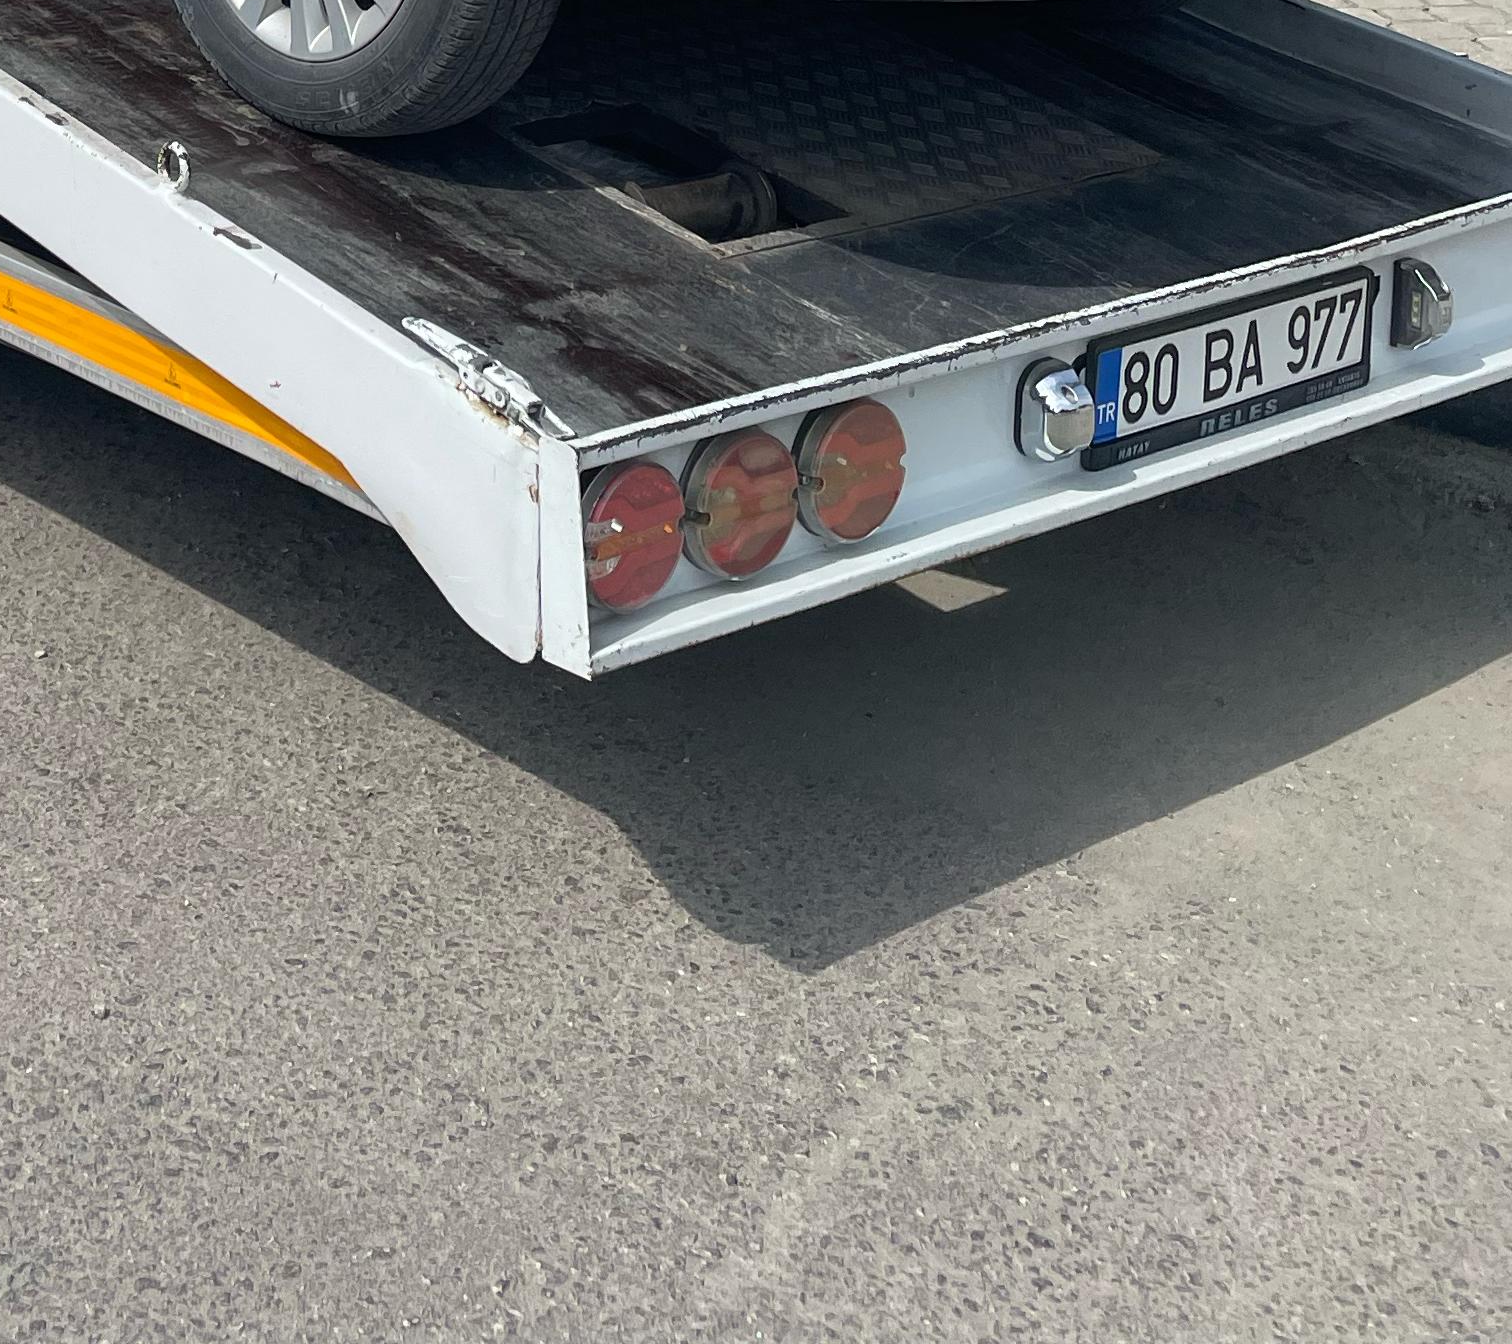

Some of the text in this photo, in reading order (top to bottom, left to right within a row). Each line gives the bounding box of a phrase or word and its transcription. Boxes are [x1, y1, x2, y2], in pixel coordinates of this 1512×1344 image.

[1096, 288, 1363, 425] TR 80 BA 977
